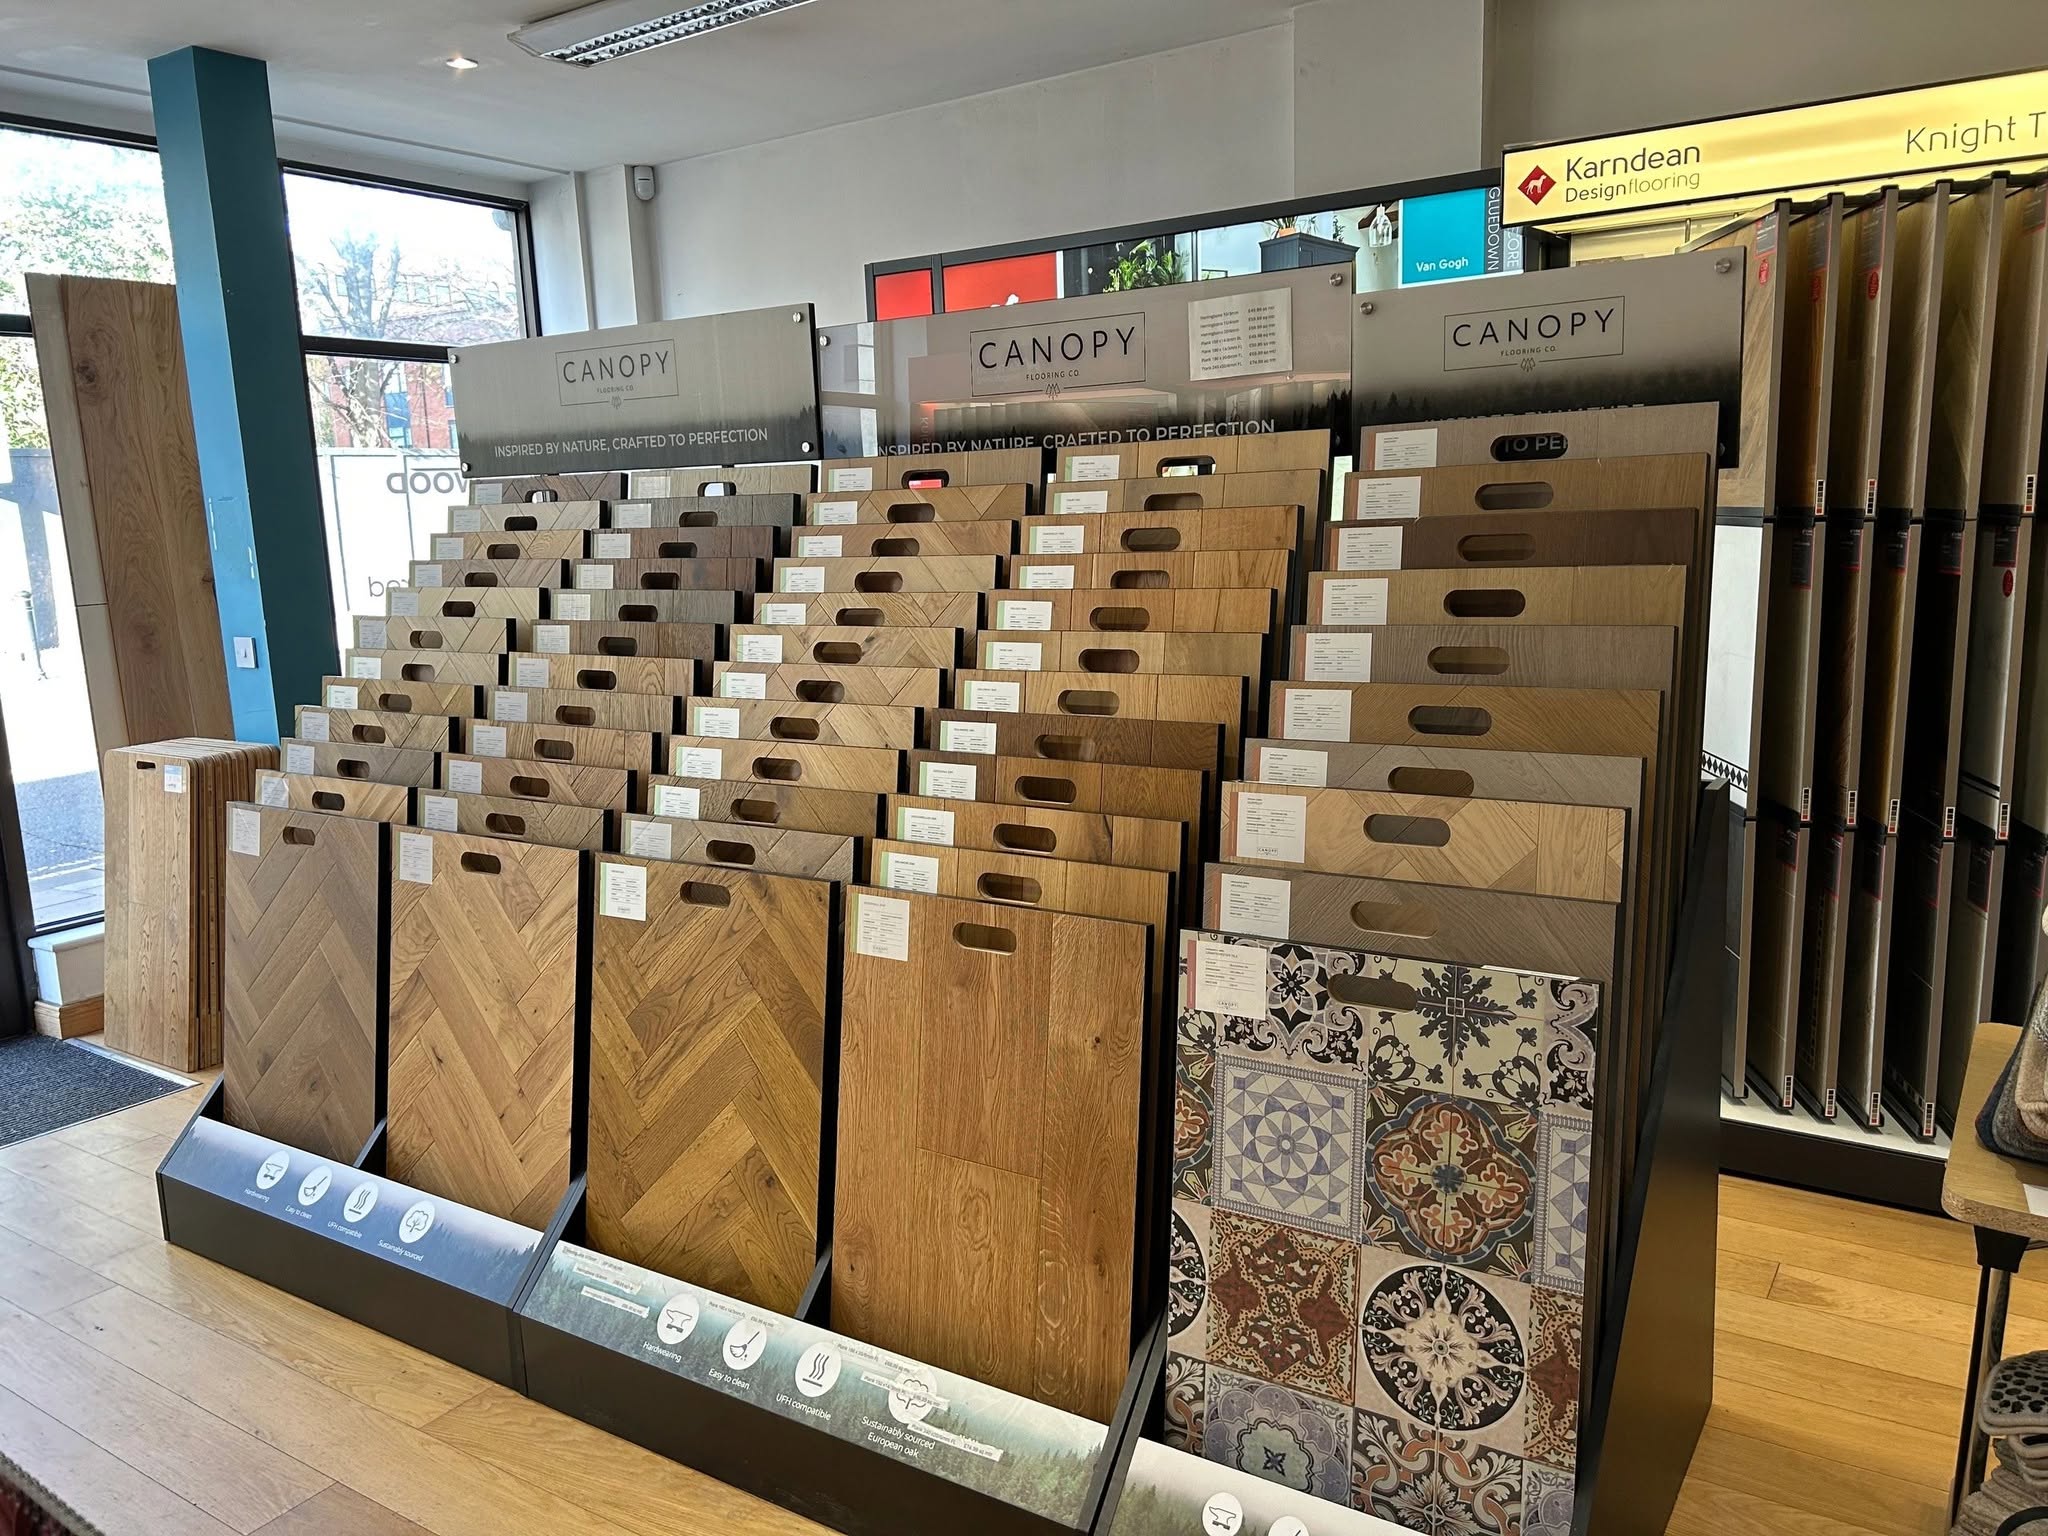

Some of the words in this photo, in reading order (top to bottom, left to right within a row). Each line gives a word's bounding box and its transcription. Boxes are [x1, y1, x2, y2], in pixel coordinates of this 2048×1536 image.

[1905, 116, 2017, 155] Knight
[1565, 145, 1702, 182] Karndean
[1565, 171, 1701, 203] Designflooring
[1487, 186, 1501, 271] GLUEDOWN
[1415, 261, 1436, 273] Van
[1438, 256, 1469, 271] Gogh
[1452, 307, 1615, 348] CANOPY
[978, 326, 1135, 369] CANOPY
[1500, 347, 1542, 357] FLOORING
[563, 350, 669, 383] CANOPY
[1025, 370, 1066, 381] FLOORING
[494, 442, 543, 458] INSPIRED
[545, 441, 561, 455] BY
[562, 437, 610, 454] NATURE,
[612, 434, 666, 451] CRAFTED
[667, 432, 686, 447] TO
[689, 427, 769, 446] PERFECTION
[877, 442, 942, 457] NSPIRED
[946, 440, 967, 453] BY
[1042, 430, 1122, 449] CRAFTED
[1126, 428, 1151, 442] TO
[1155, 418, 1276, 441] PERFECTION
[403, 1247, 425, 1262] sourced
[642, 1340, 682, 1363] Hardwearing
[708, 1367, 725, 1382] Easy
[724, 1372, 732, 1383] to
[732, 1374, 750, 1391] clean
[775, 1392, 792, 1408] UFH
[791, 1398, 832, 1421] compatible
[861, 1415, 904, 1441] Sustainably
[903, 1430, 936, 1451] sourced
[867, 1431, 904, 1453] European
[902, 1444, 920, 1458] oak
